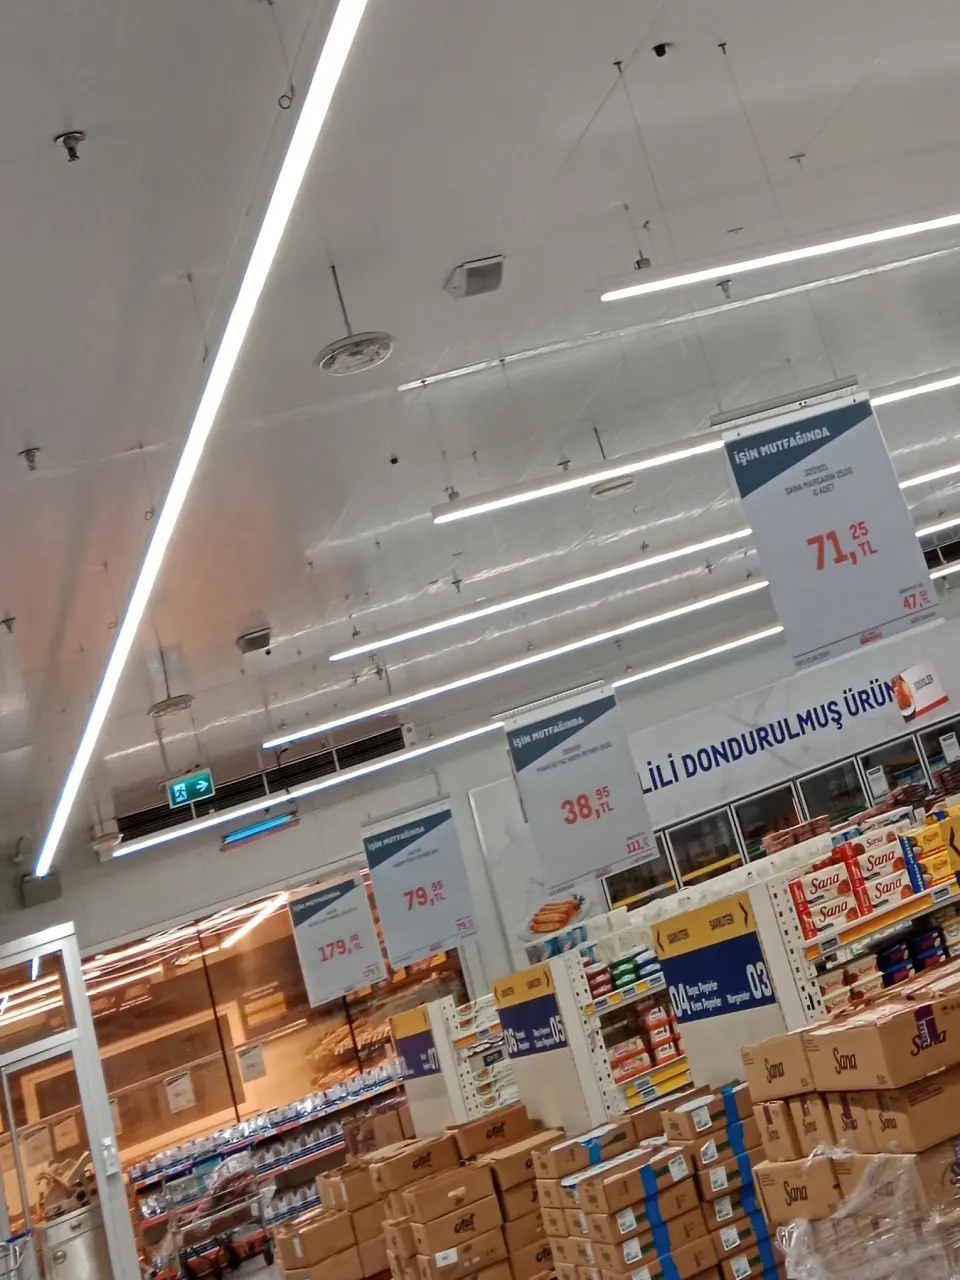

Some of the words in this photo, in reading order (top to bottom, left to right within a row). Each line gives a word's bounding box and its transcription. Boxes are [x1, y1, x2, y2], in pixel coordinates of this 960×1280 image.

[733, 448, 759, 466] İŞİN
[760, 426, 830, 457] MUTFAĞINDA
[849, 521, 869, 540] 25
[858, 540, 878, 557] TL
[682, 700, 843, 779] DONDURULMUŞ
[866, 850, 895, 871] Sana
[810, 873, 840, 894] Sana
[874, 878, 902, 899] Sana
[819, 900, 848, 922] Sana
[746, 961, 772, 999] 03
[668, 983, 692, 1017] 04
[764, 1058, 784, 1084] Sana
[833, 1047, 857, 1074] Sana
[880, 1110, 897, 1132] Sana
[783, 1180, 809, 1206] Sana
